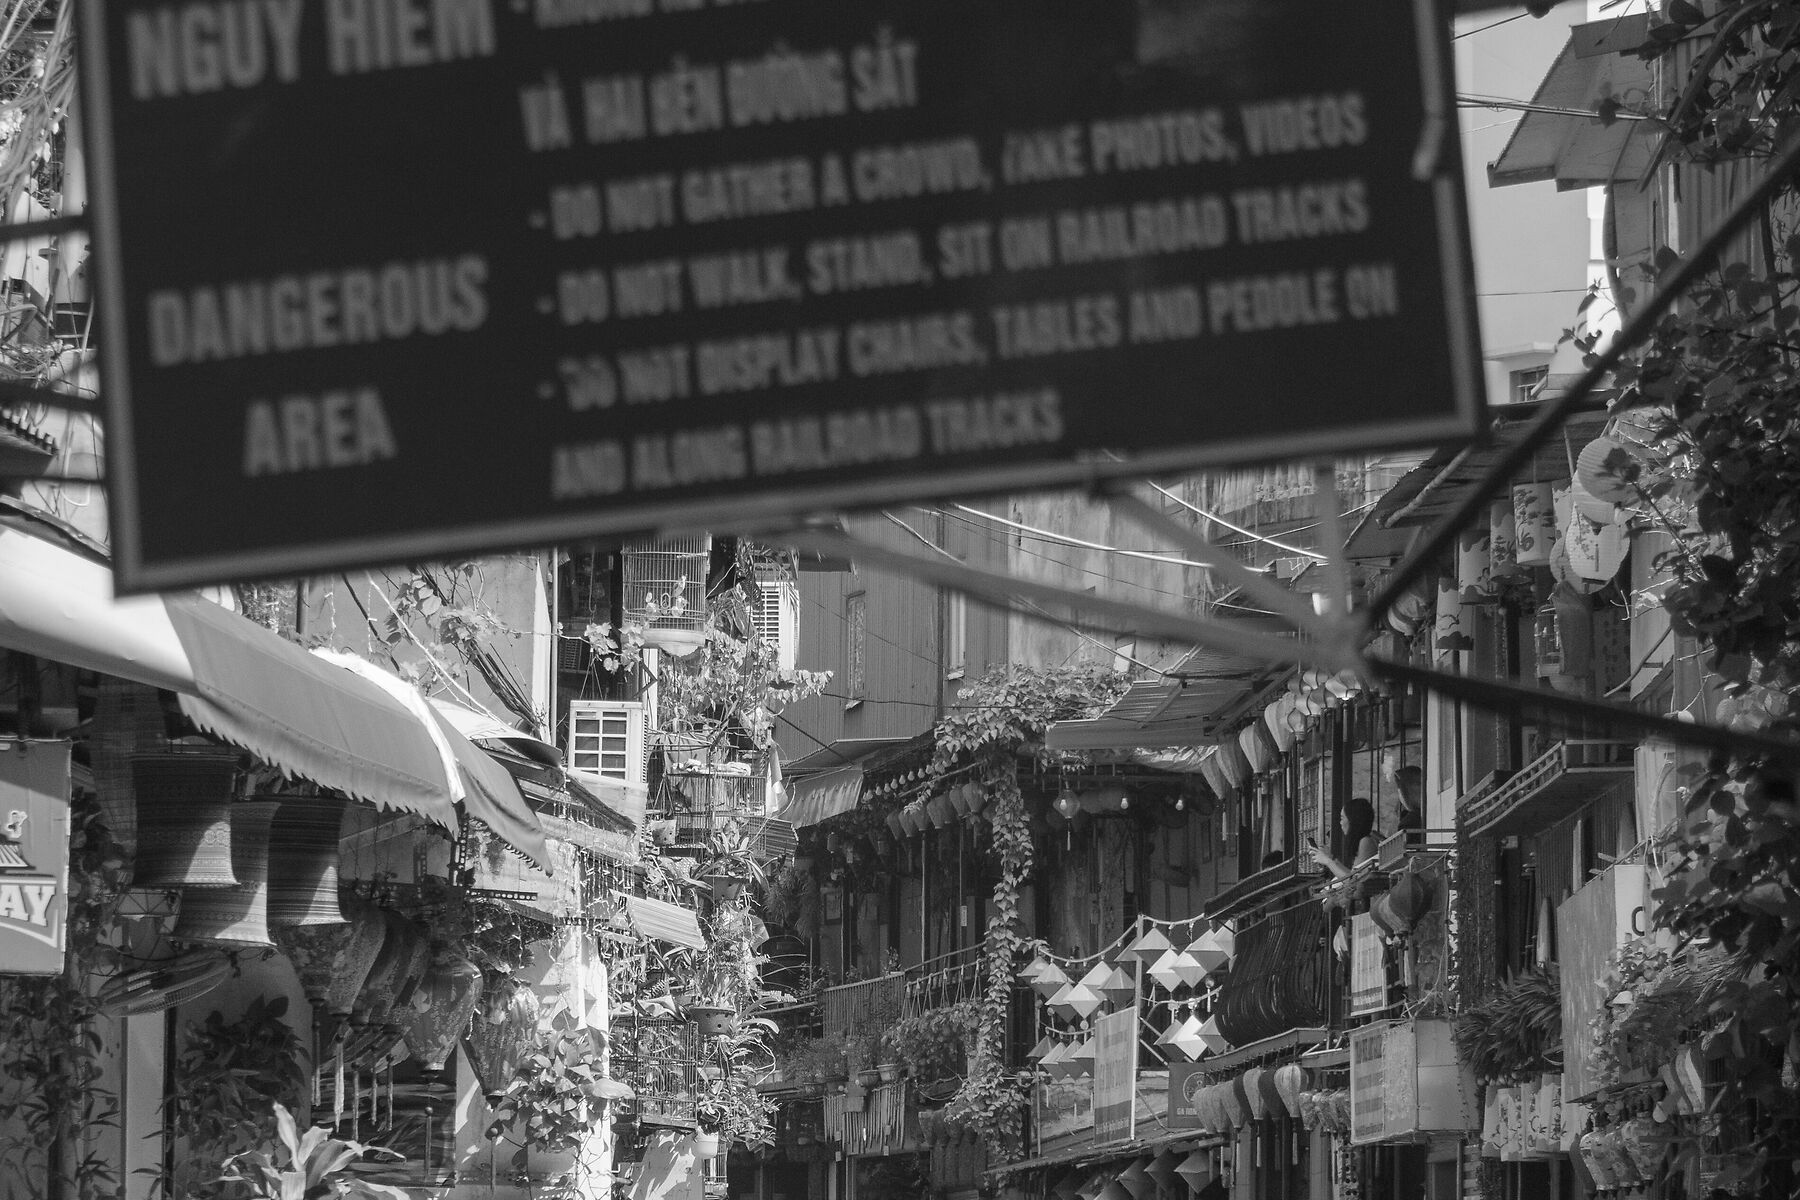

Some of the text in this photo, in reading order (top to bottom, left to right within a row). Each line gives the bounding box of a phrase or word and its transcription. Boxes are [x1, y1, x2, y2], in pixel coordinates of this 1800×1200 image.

[127, 0, 301, 98] NGUY
[550, 92, 1368, 241] DO NOT GATHER A CROWD, TAKE PHOTOS, VIDEOS
[149, 253, 488, 366] DANGEROUS
[557, 178, 1369, 327] DO NOT WALK, STAND, SIT ON RAILROAD TRACKS
[557, 261, 1399, 412] DO NOT DISPLAY CHAIRS, TABLES AND PEDDLE ON
[243, 386, 397, 477] AREA
[551, 386, 1065, 500] AND ALONG RAILROAD TRACKS
